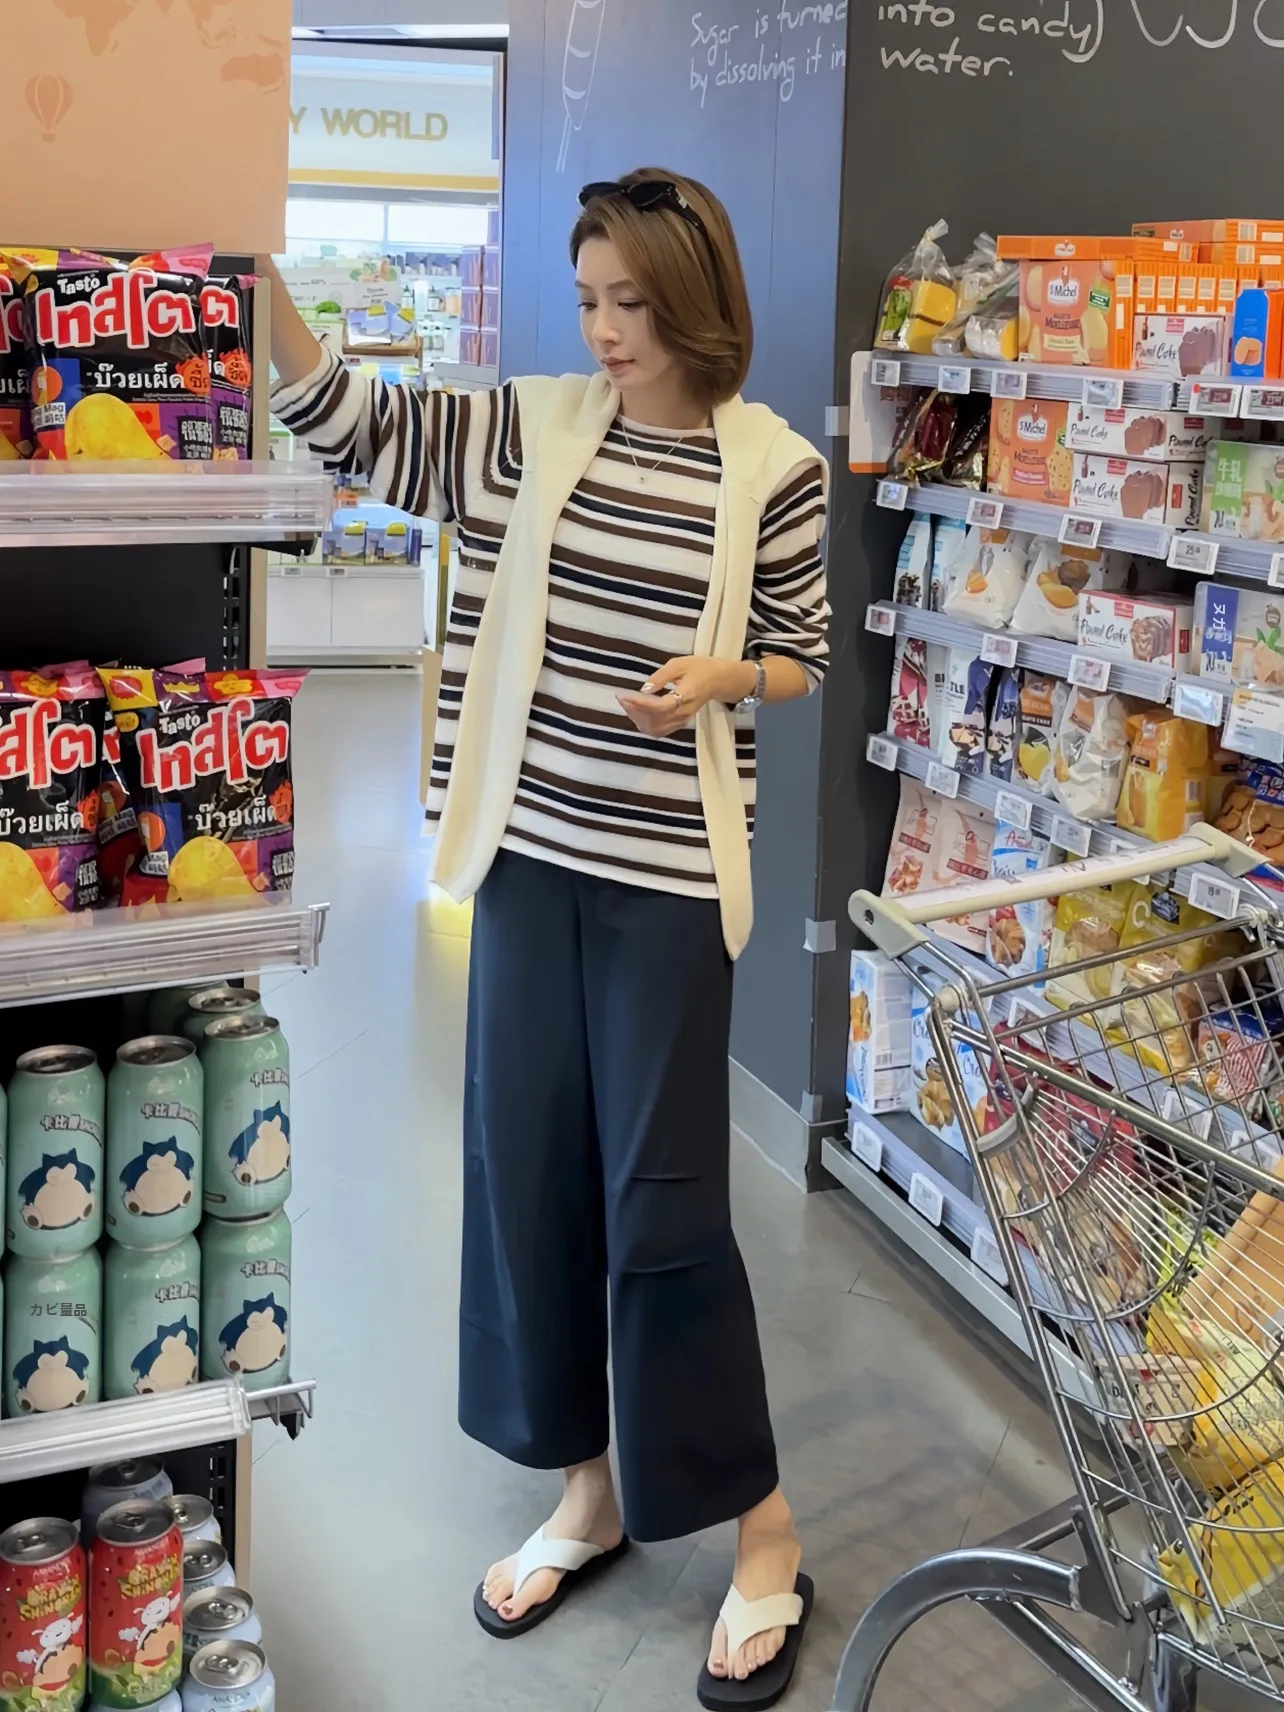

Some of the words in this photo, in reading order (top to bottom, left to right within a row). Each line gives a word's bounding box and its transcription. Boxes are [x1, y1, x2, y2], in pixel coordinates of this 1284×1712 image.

[690, 12, 739, 66] Sugar
[755, 9, 769, 38] is
[878, 0, 955, 27] into
[977, 0, 1091, 53] candy
[690, 58, 708, 109] by
[715, 45, 795, 102] dissolving
[806, 36, 822, 75] it
[831, 43, 845, 70] in
[880, 37, 1014, 76] water.
[320, 107, 448, 141] WORLD
[30, 1302, 87, 1317] カビ量品
